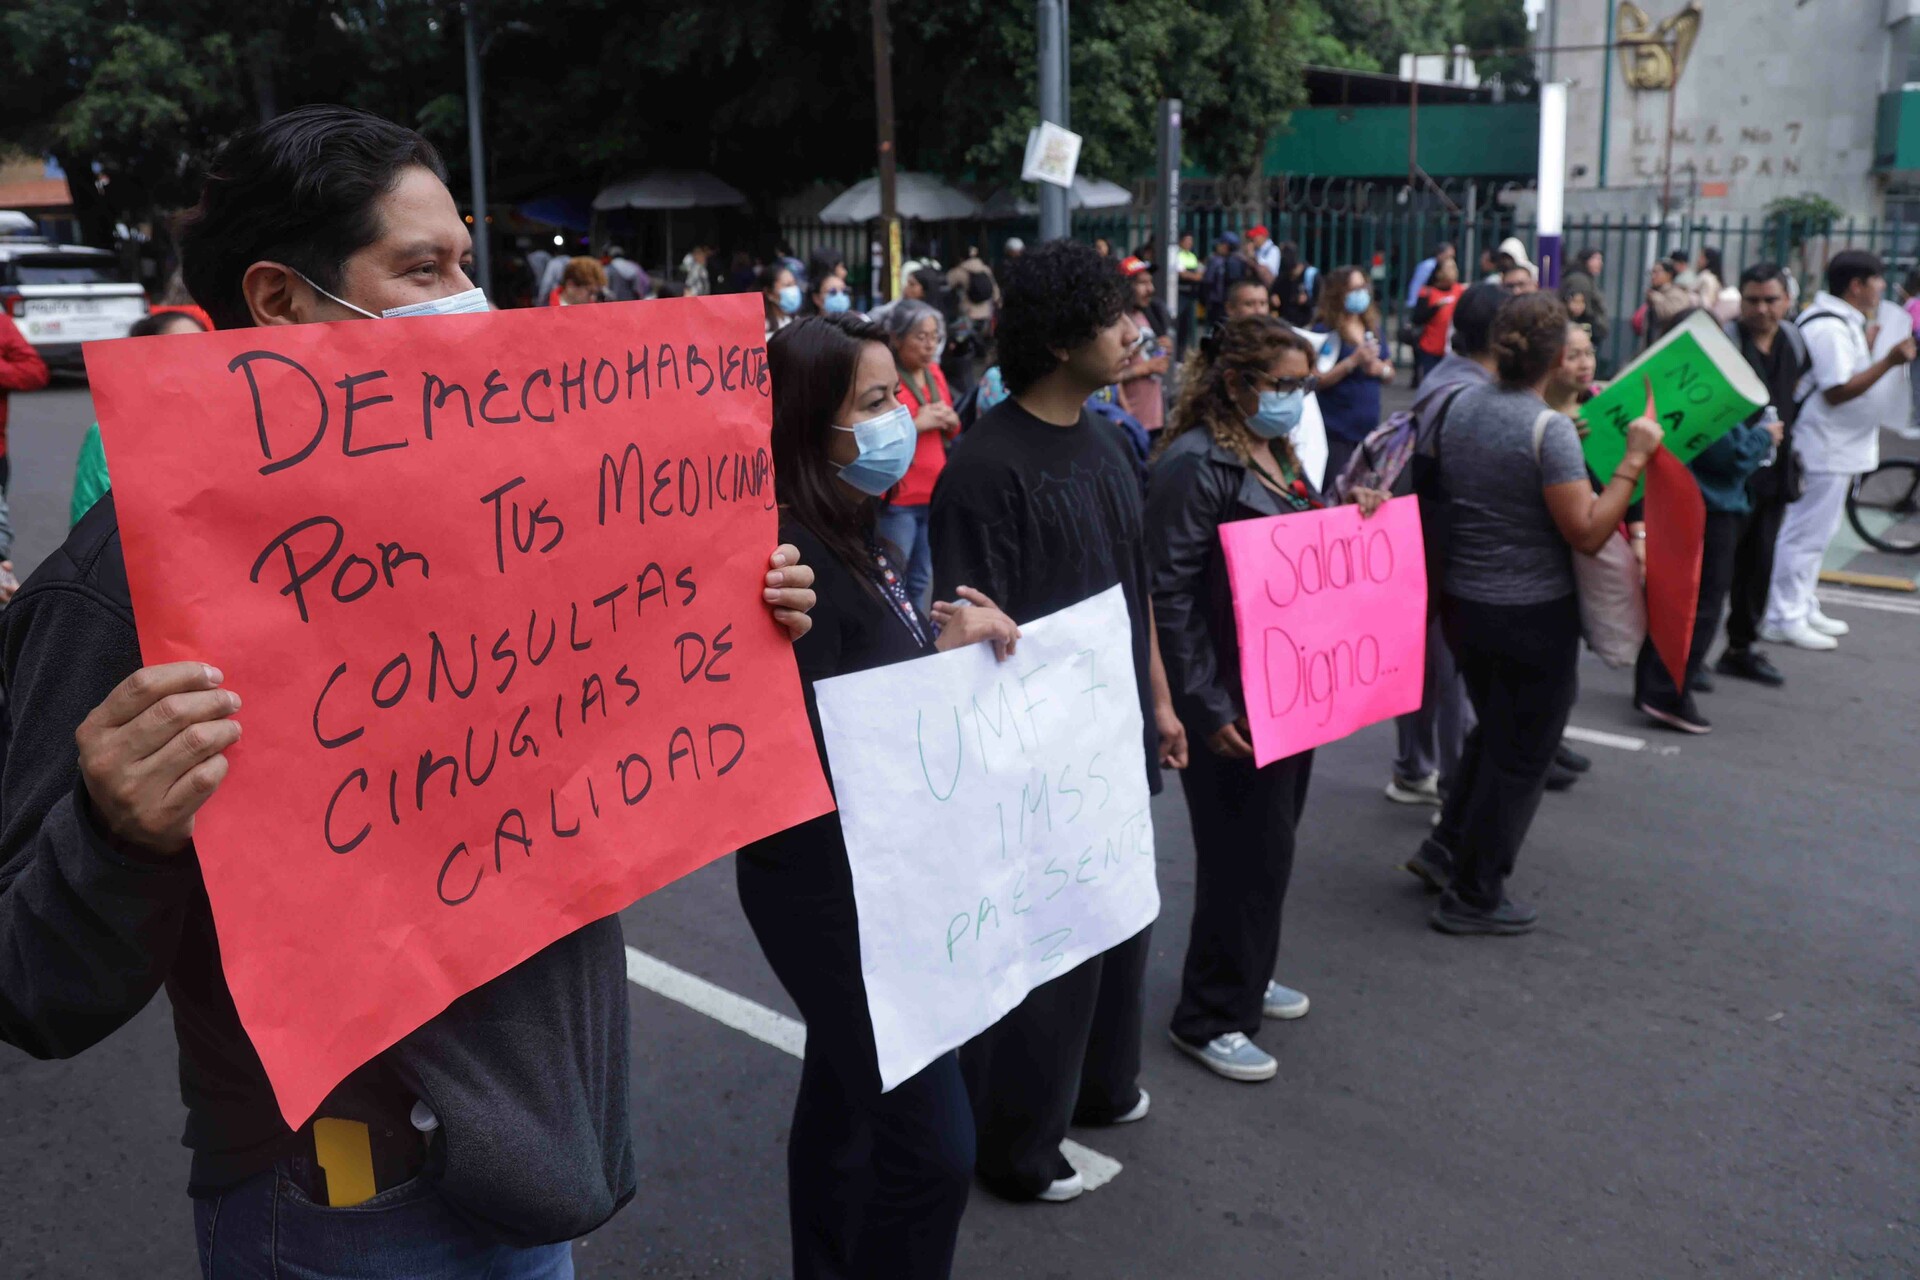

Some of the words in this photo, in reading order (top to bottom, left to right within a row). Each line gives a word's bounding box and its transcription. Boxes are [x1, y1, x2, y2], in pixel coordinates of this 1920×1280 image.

[1265, 521, 1394, 608] Salario
[313, 563, 698, 748] CONSULTAS
[918, 663, 1048, 801] UMF
[1077, 648, 1107, 722] 7
[324, 673, 640, 854] CIRUGIAS
[675, 625, 732, 683] DE
[436, 723, 745, 905] CALIDAD
[996, 752, 1111, 860] IMSS
